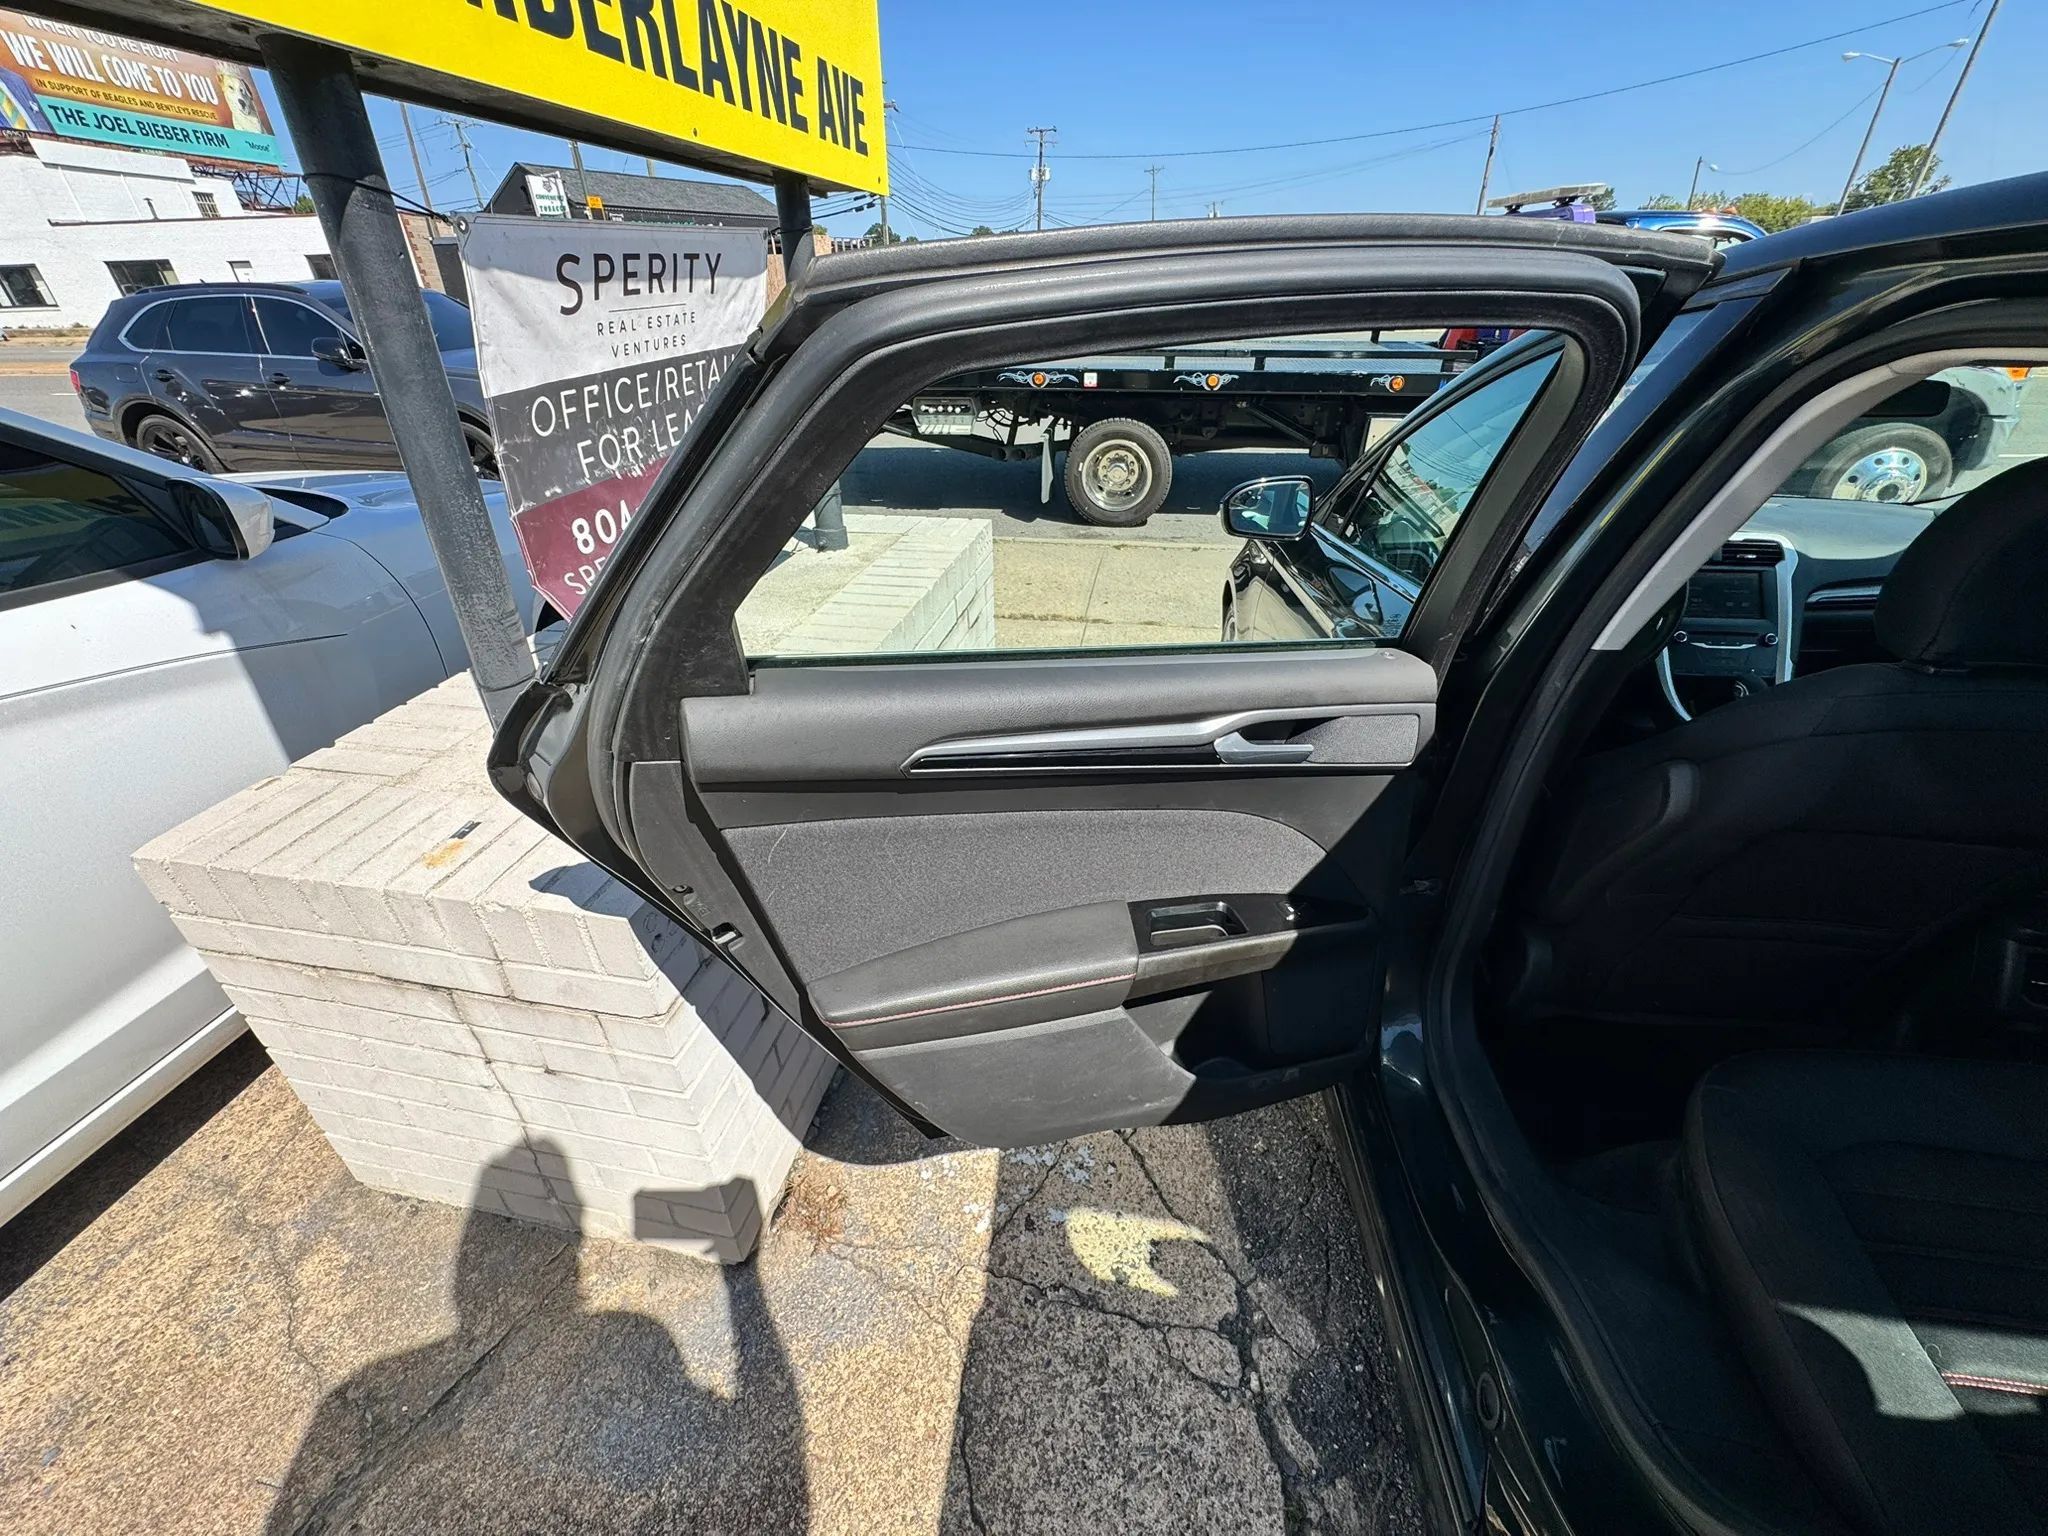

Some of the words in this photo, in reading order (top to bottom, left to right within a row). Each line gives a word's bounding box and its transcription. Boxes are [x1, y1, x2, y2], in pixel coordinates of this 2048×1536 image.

[0, 29, 52, 72] WE
[42, 39, 106, 83] WILL
[101, 54, 159, 94] COME
[152, 65, 182, 99] TO
[178, 71, 219, 106] YOU
[35, 79, 48, 89] IN
[47, 80, 88, 96] SUPPORT
[91, 89, 102, 99] OF
[102, 92, 139, 106] BEAGLES
[139, 99, 155, 109] AND
[817, 57, 869, 156] AVE
[48, 105, 91, 128] THE
[92, 112, 138, 135] JOEL
[135, 120, 194, 144] BIEBER
[192, 129, 230, 149] FIRM
[556, 252, 722, 316] SPERITY
[597, 318, 637, 336] REAL
[647, 311, 697, 329] ESTATE
[611, 333, 687, 358] VENTURES
[576, 427, 645, 479] FOR
